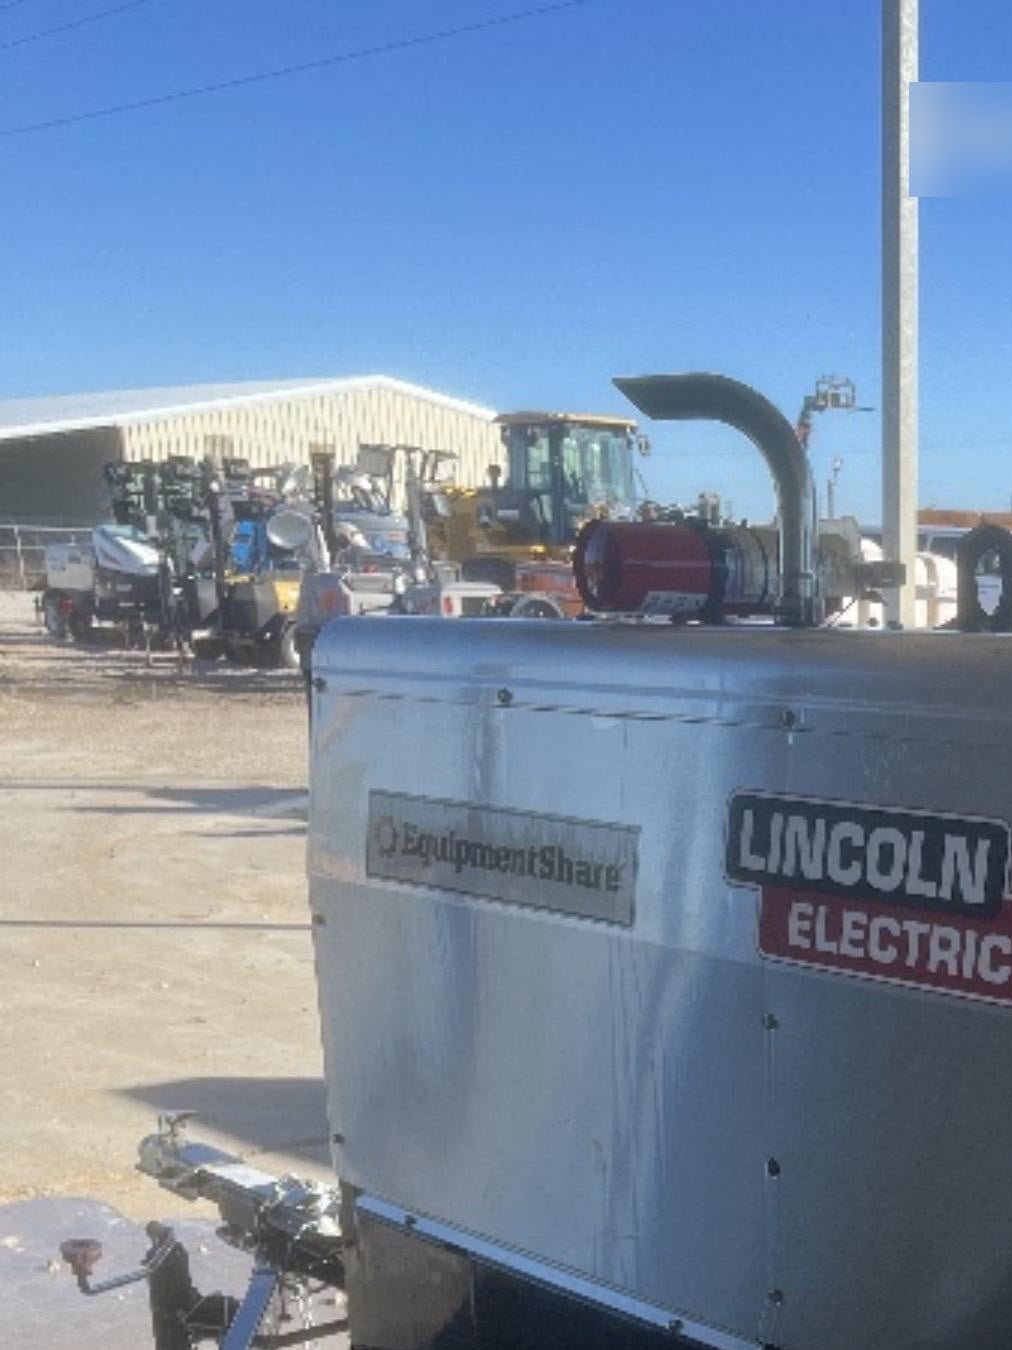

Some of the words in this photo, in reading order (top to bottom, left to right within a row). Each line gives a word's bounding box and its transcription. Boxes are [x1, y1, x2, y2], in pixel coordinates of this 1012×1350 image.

[402, 822, 621, 892] EquipmentShare
[739, 809, 991, 904] LINCOLN
[787, 902, 1012, 985] ELECTRIC
